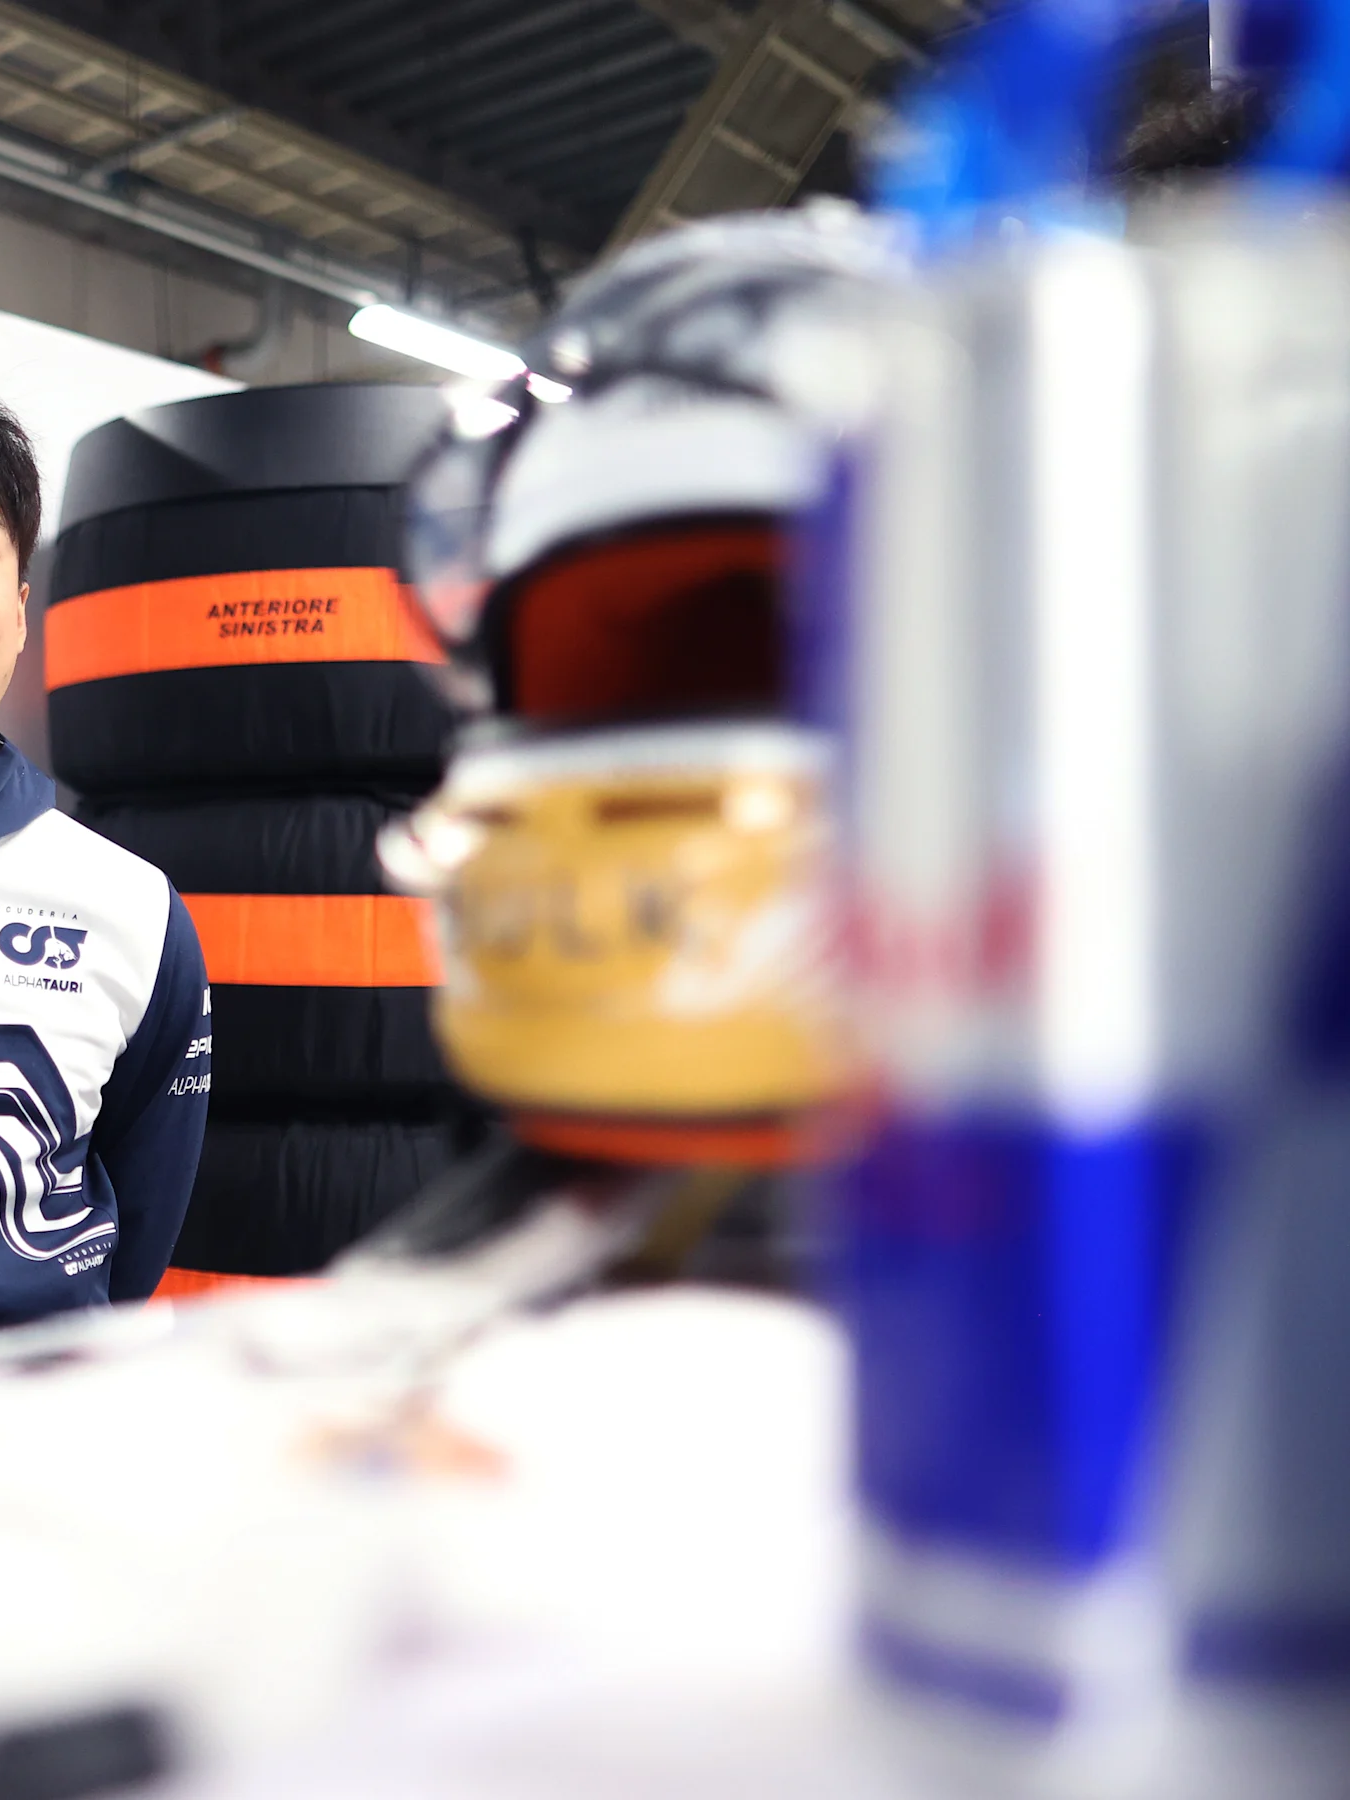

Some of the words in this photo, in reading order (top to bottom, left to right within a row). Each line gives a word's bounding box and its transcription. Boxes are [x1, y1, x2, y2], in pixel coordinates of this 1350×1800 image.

[206, 598, 339, 619] ANTERIORE
[219, 619, 324, 638] SINISTRA
[4, 974, 83, 993] ALPHATAURI
